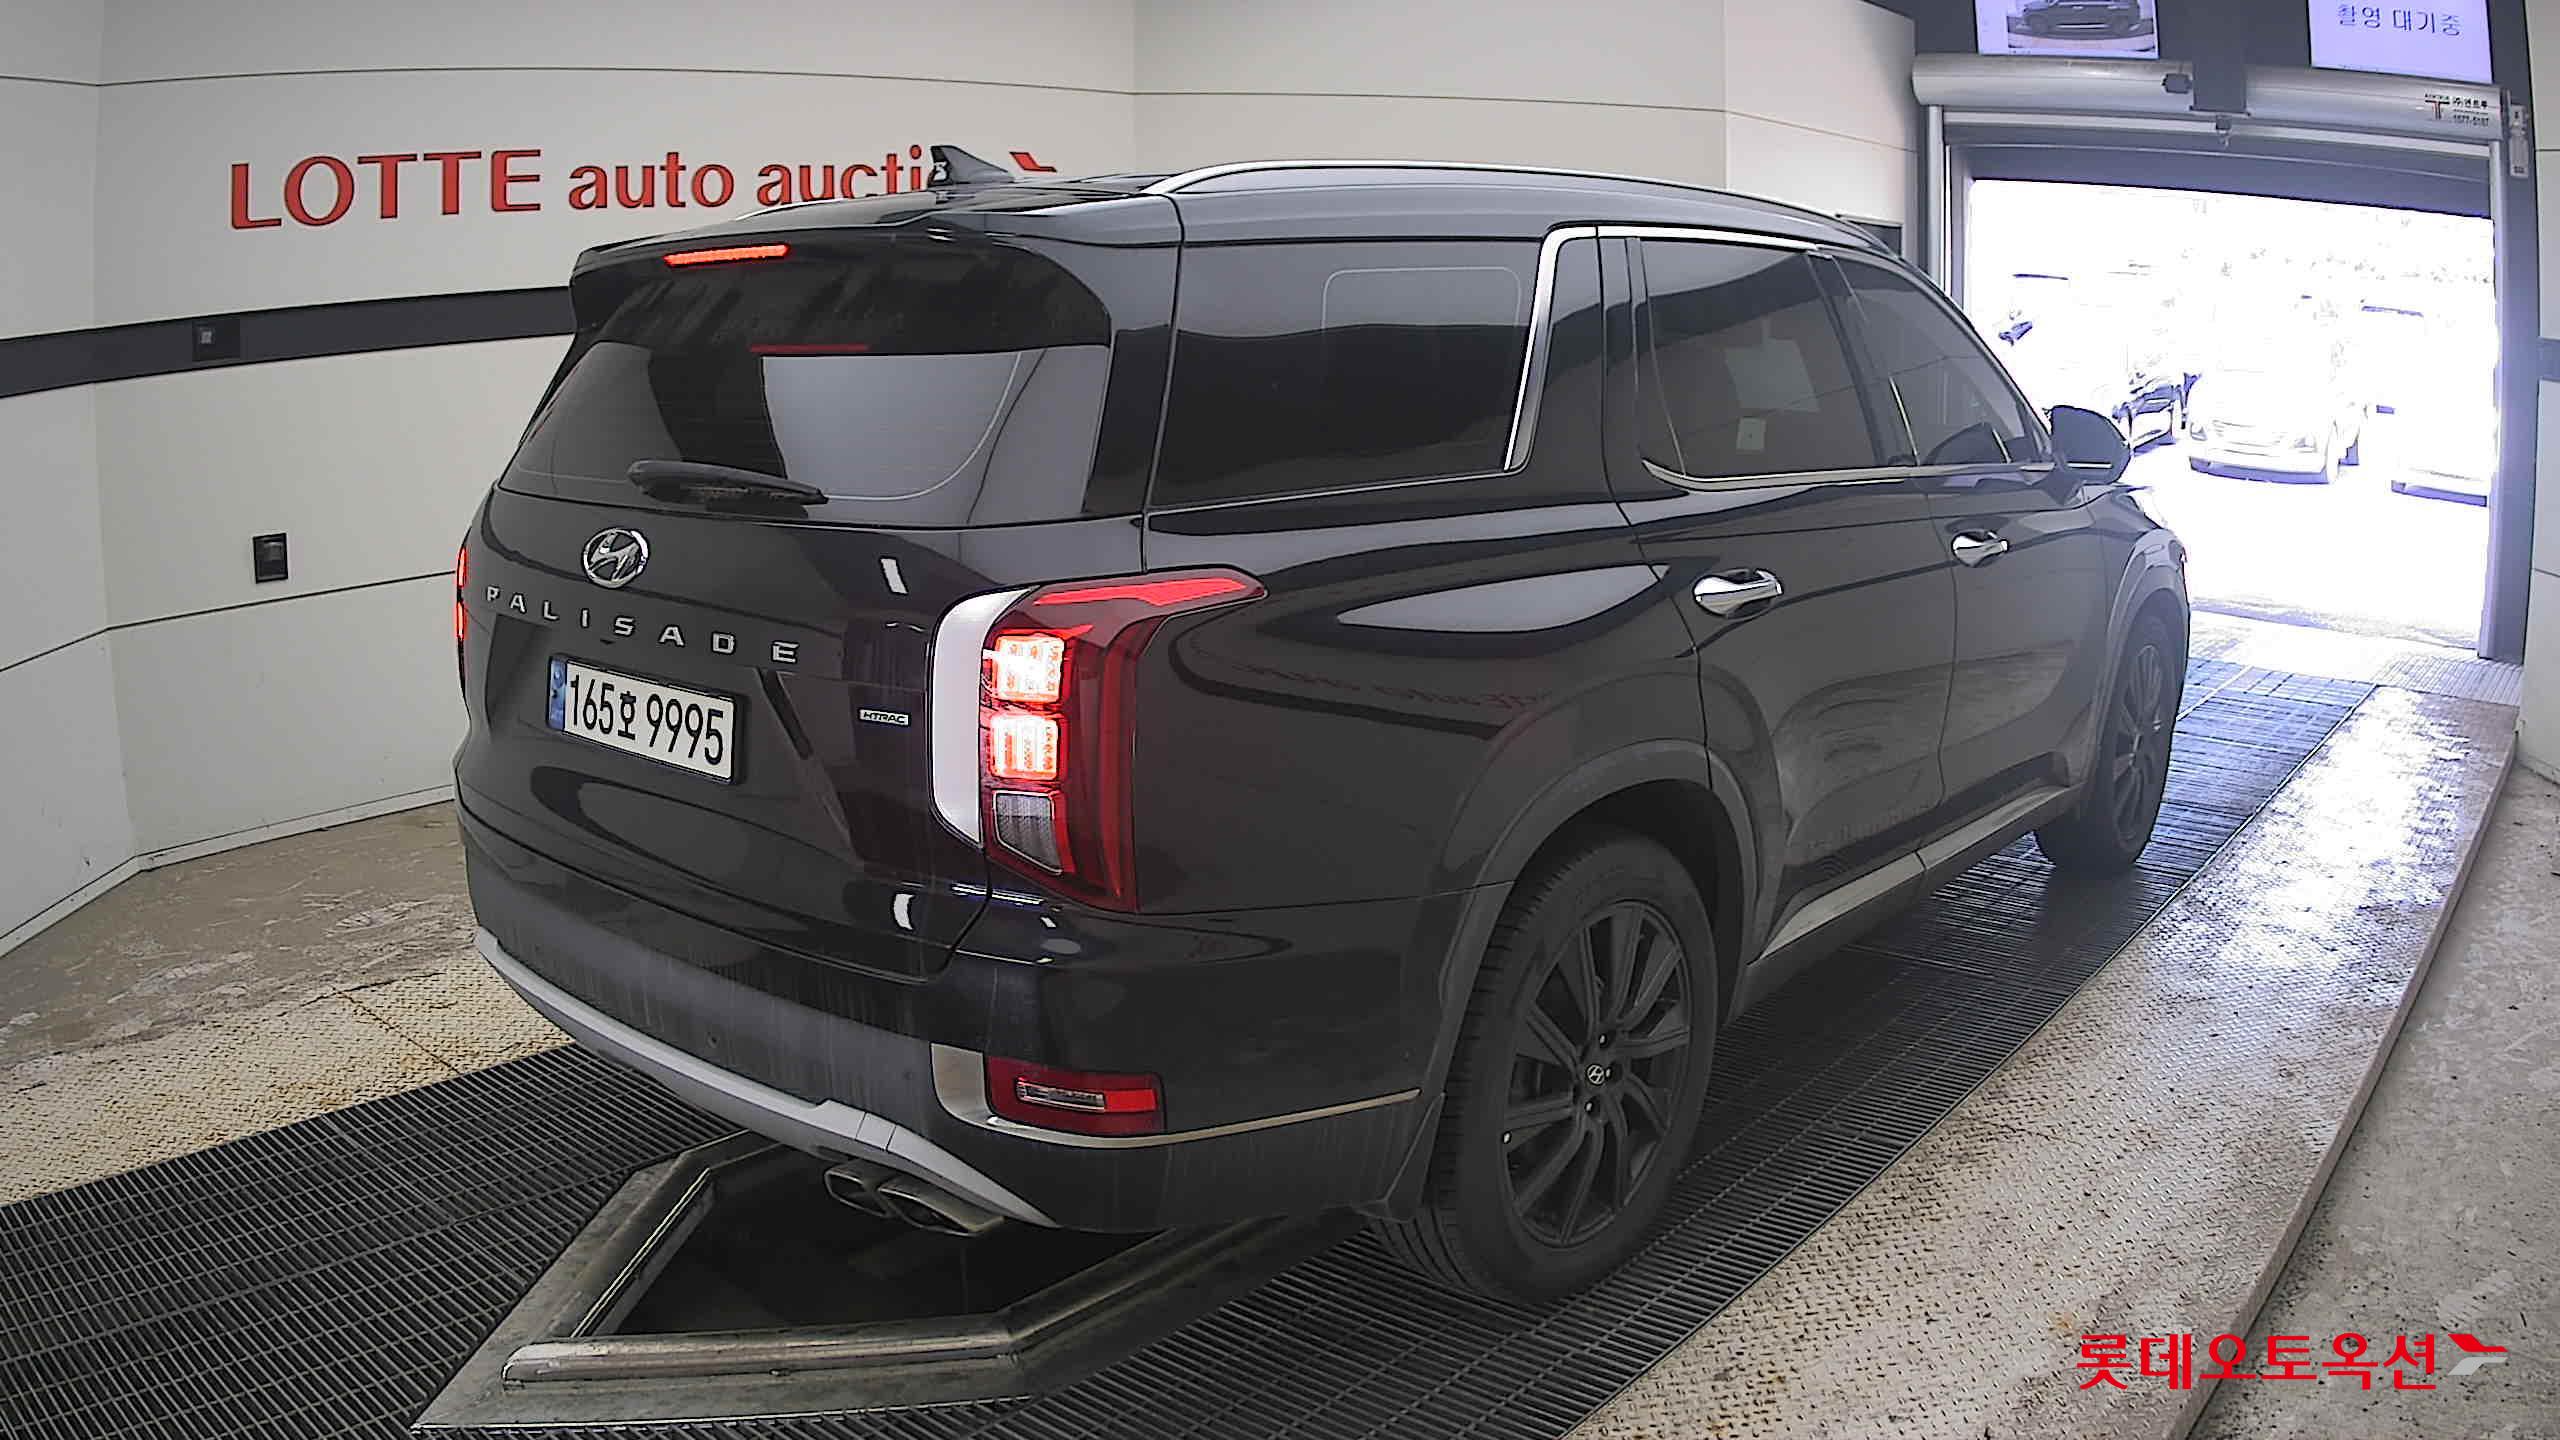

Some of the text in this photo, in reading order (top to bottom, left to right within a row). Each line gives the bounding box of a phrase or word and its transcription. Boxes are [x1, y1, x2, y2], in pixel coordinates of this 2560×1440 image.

[2391, 7, 2461, 38] 대기중
[230, 144, 934, 231] LOTTE auto aucti
[486, 584, 800, 665] PALISADE
[569, 673, 725, 767] 165호 9995
[862, 711, 906, 724] HTRAC
